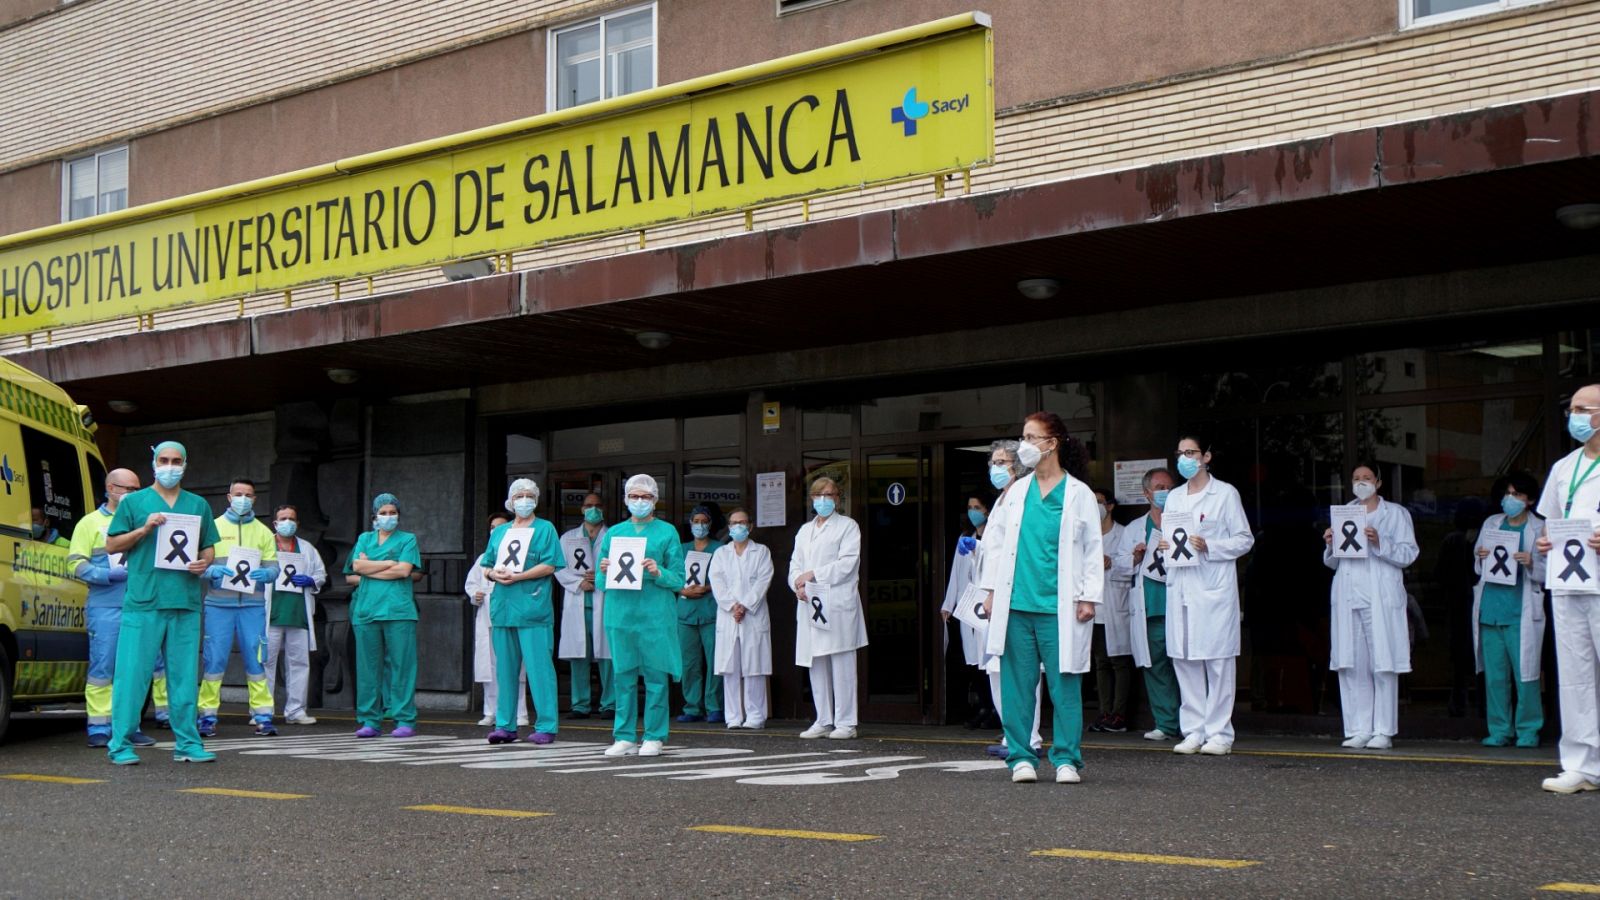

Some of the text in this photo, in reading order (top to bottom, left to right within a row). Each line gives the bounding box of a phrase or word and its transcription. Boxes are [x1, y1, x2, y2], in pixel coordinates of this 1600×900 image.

[931, 93, 969, 115] Sacyl
[2, 89, 861, 319] HOSPITAL UNIVERSITARIO DE SALAMANCA
[32, 595, 86, 628] Sanitarias
